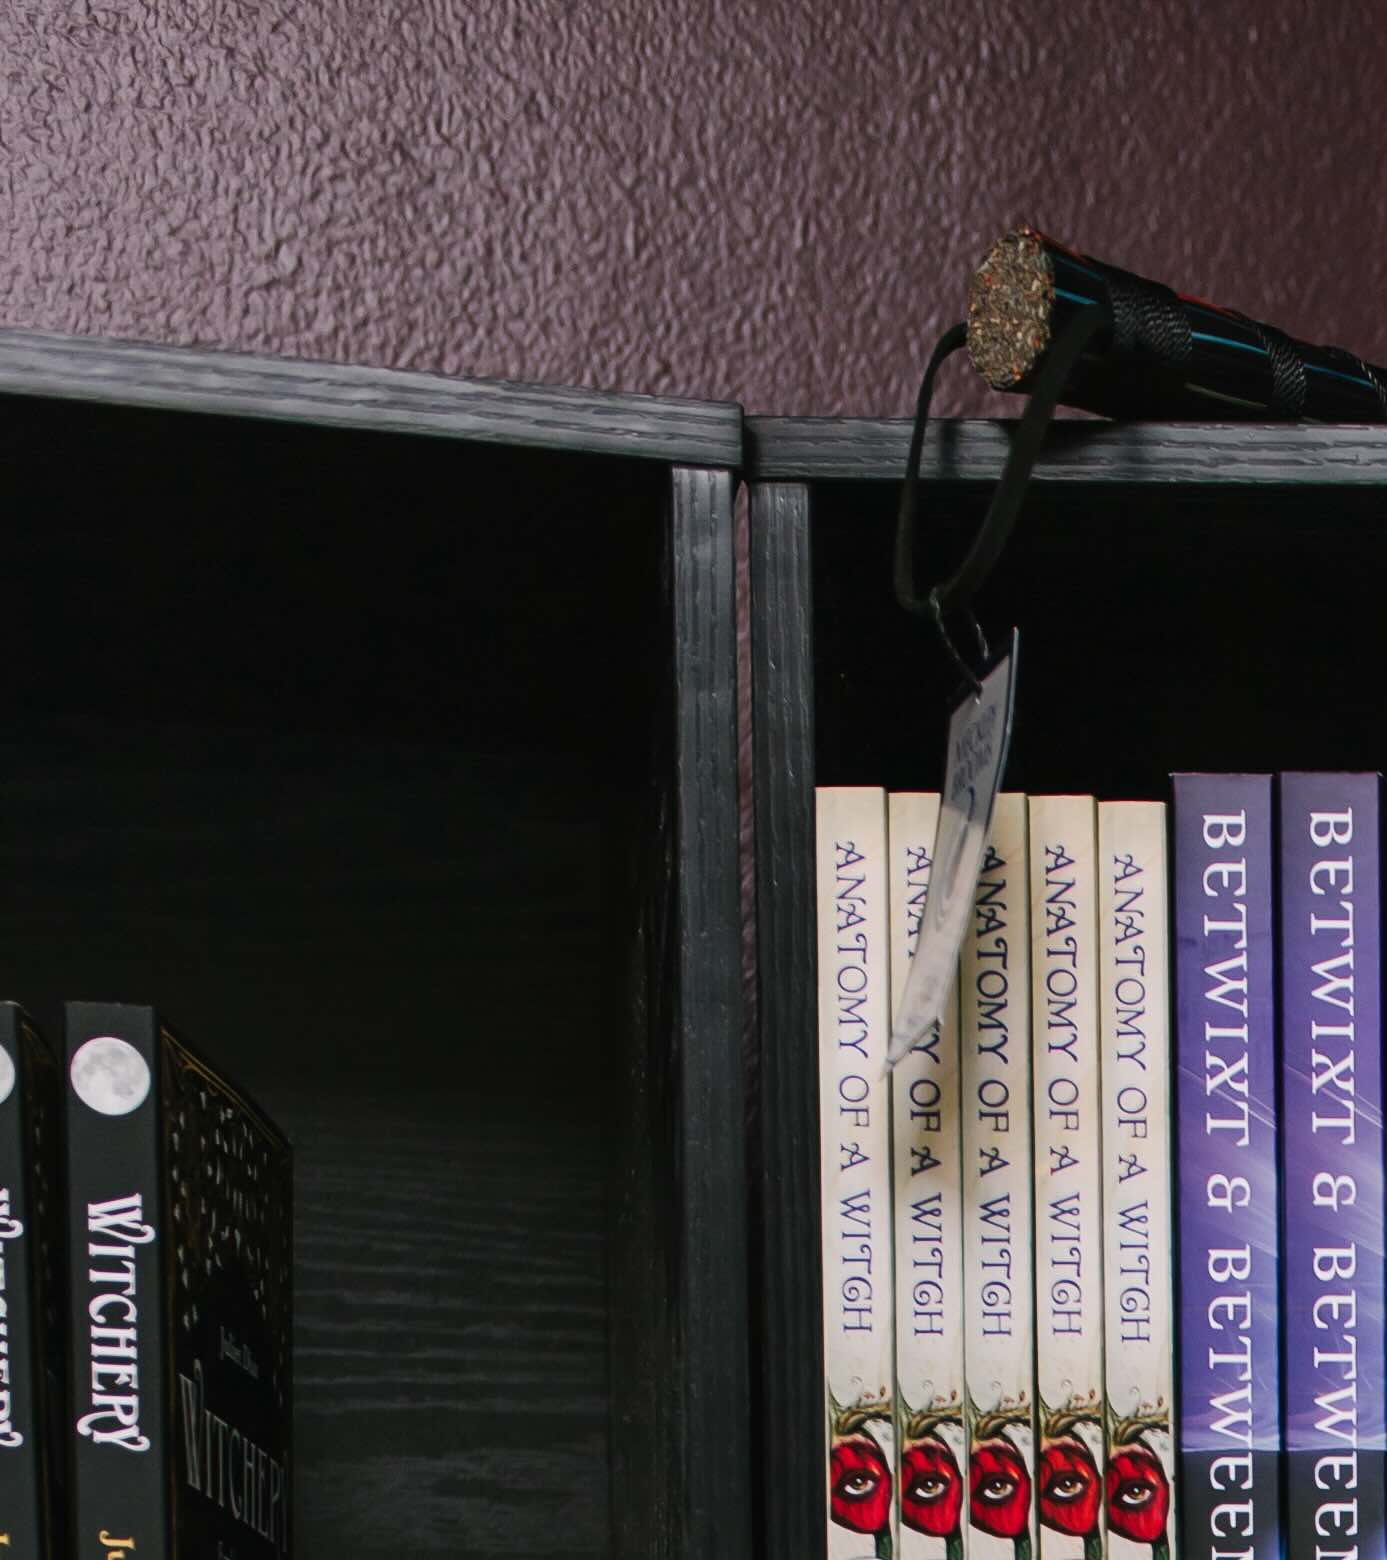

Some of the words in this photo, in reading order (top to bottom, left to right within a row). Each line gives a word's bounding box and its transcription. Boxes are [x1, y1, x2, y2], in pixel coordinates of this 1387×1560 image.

[834, 838, 871, 1071] ANATOMY
[1201, 809, 1252, 1147] BETWIXT
[839, 1078, 871, 1132] OF
[841, 1142, 871, 1173] A
[841, 1188, 874, 1335] WITCH
[1206, 1169, 1250, 1214] &
[77, 1192, 153, 1453] WITCHERY
